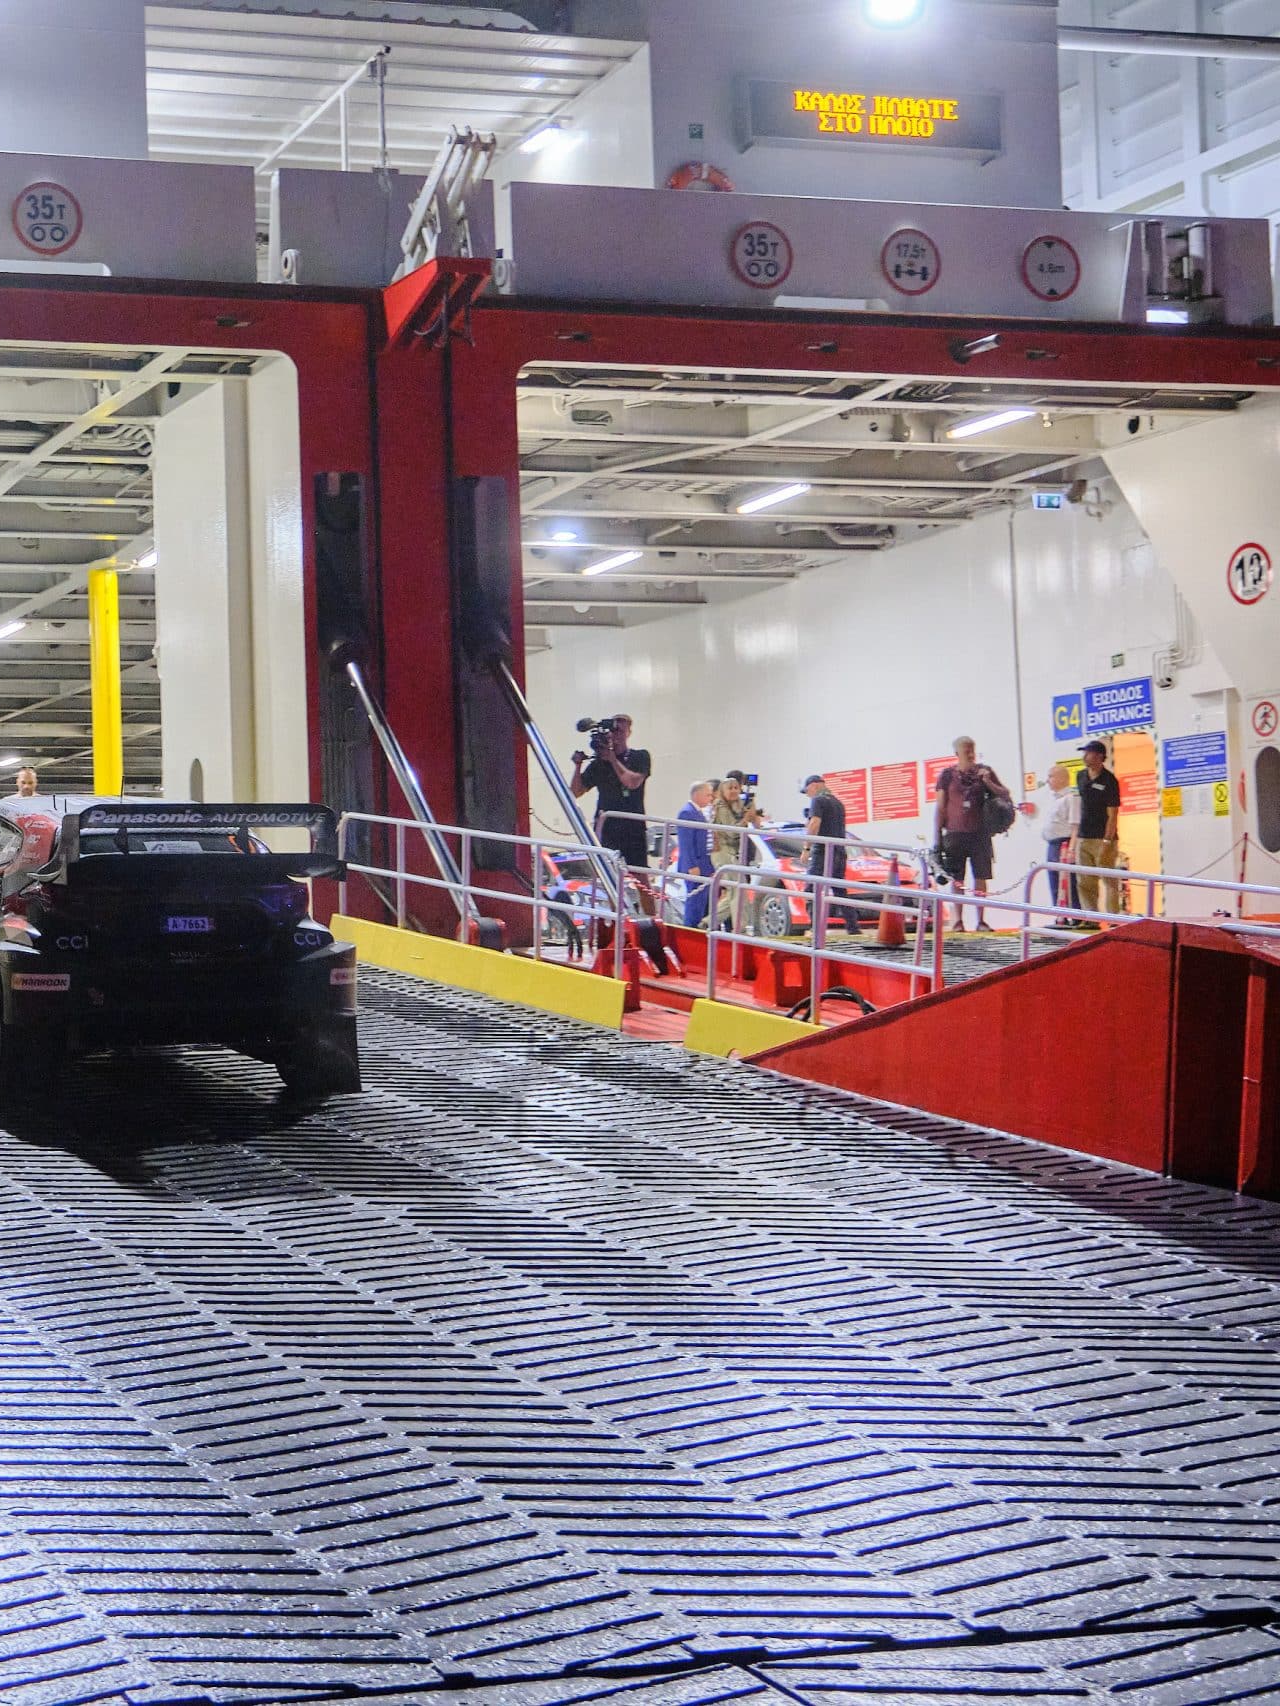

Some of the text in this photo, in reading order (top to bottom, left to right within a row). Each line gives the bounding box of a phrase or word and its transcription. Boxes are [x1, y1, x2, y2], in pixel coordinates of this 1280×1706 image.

[794, 90, 866, 114] ΚΑΛΩΣ
[819, 111, 936, 137] ΣΤΟ ΠΛΟΙΟ
[1092, 684, 1145, 708] ΕΙΣΟΔΟΣ
[1055, 703, 1080, 730] G4
[1087, 702, 1153, 727] ENTRANCE
[88, 809, 327, 824] Panasonic AUTOMOTIVE
